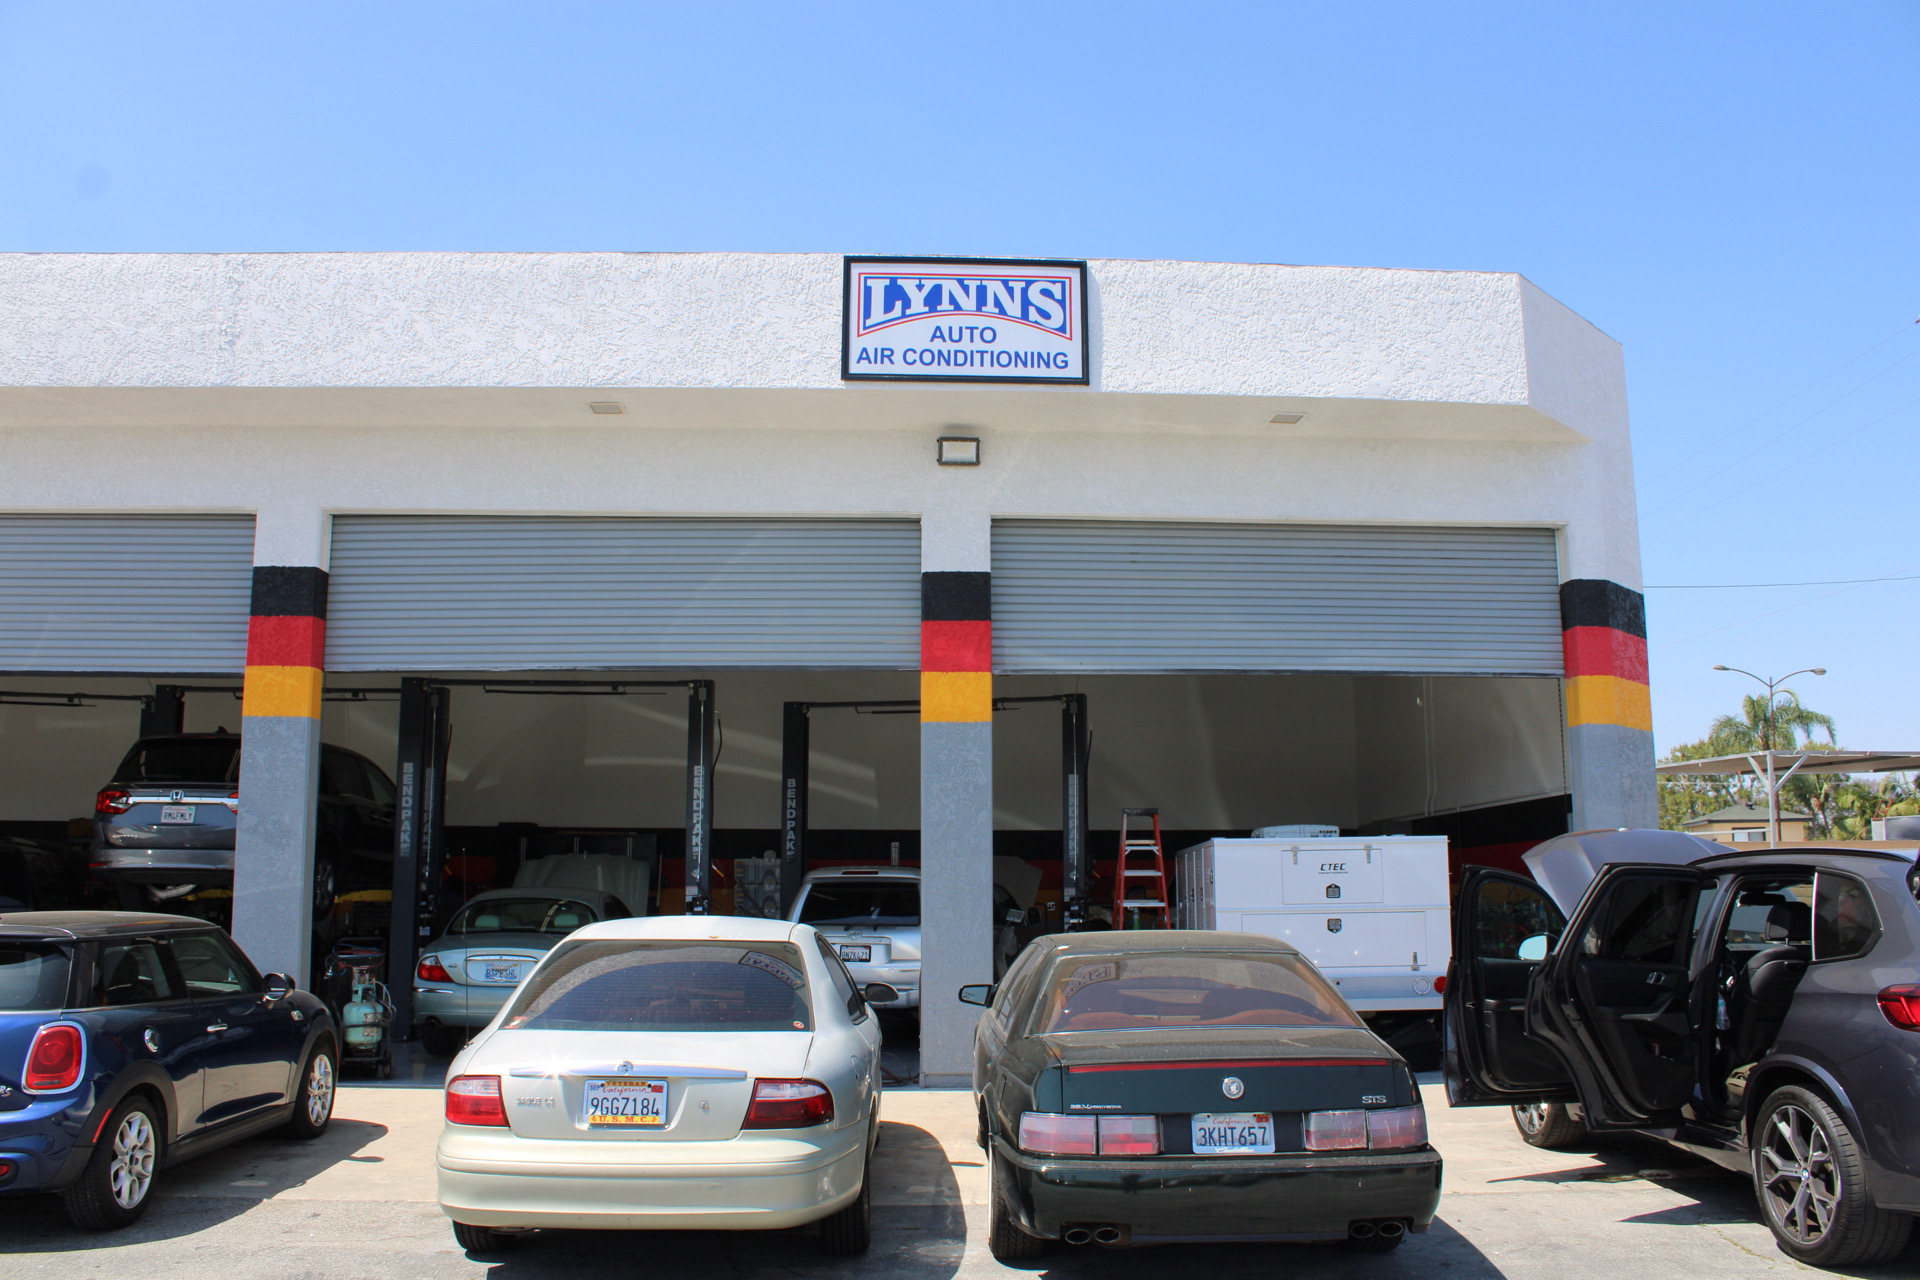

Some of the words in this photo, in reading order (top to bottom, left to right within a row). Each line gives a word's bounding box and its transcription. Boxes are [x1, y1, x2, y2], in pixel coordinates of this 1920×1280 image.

[865, 278, 1065, 329] LYNNS
[929, 325, 997, 344] AUTO
[856, 347, 895, 365] AIR
[902, 348, 1069, 370] CONDITIONING
[401, 761, 414, 843] BENDPAK
[786, 778, 797, 850] BENDPAK
[1320, 863, 1347, 871] CTEC
[602, 1086, 648, 1096] California
[1361, 1095, 1387, 1104] STS
[590, 1097, 660, 1116] 9GGZ184
[1212, 1116, 1254, 1126] California
[1198, 1126, 1267, 1147] 3KHT657
